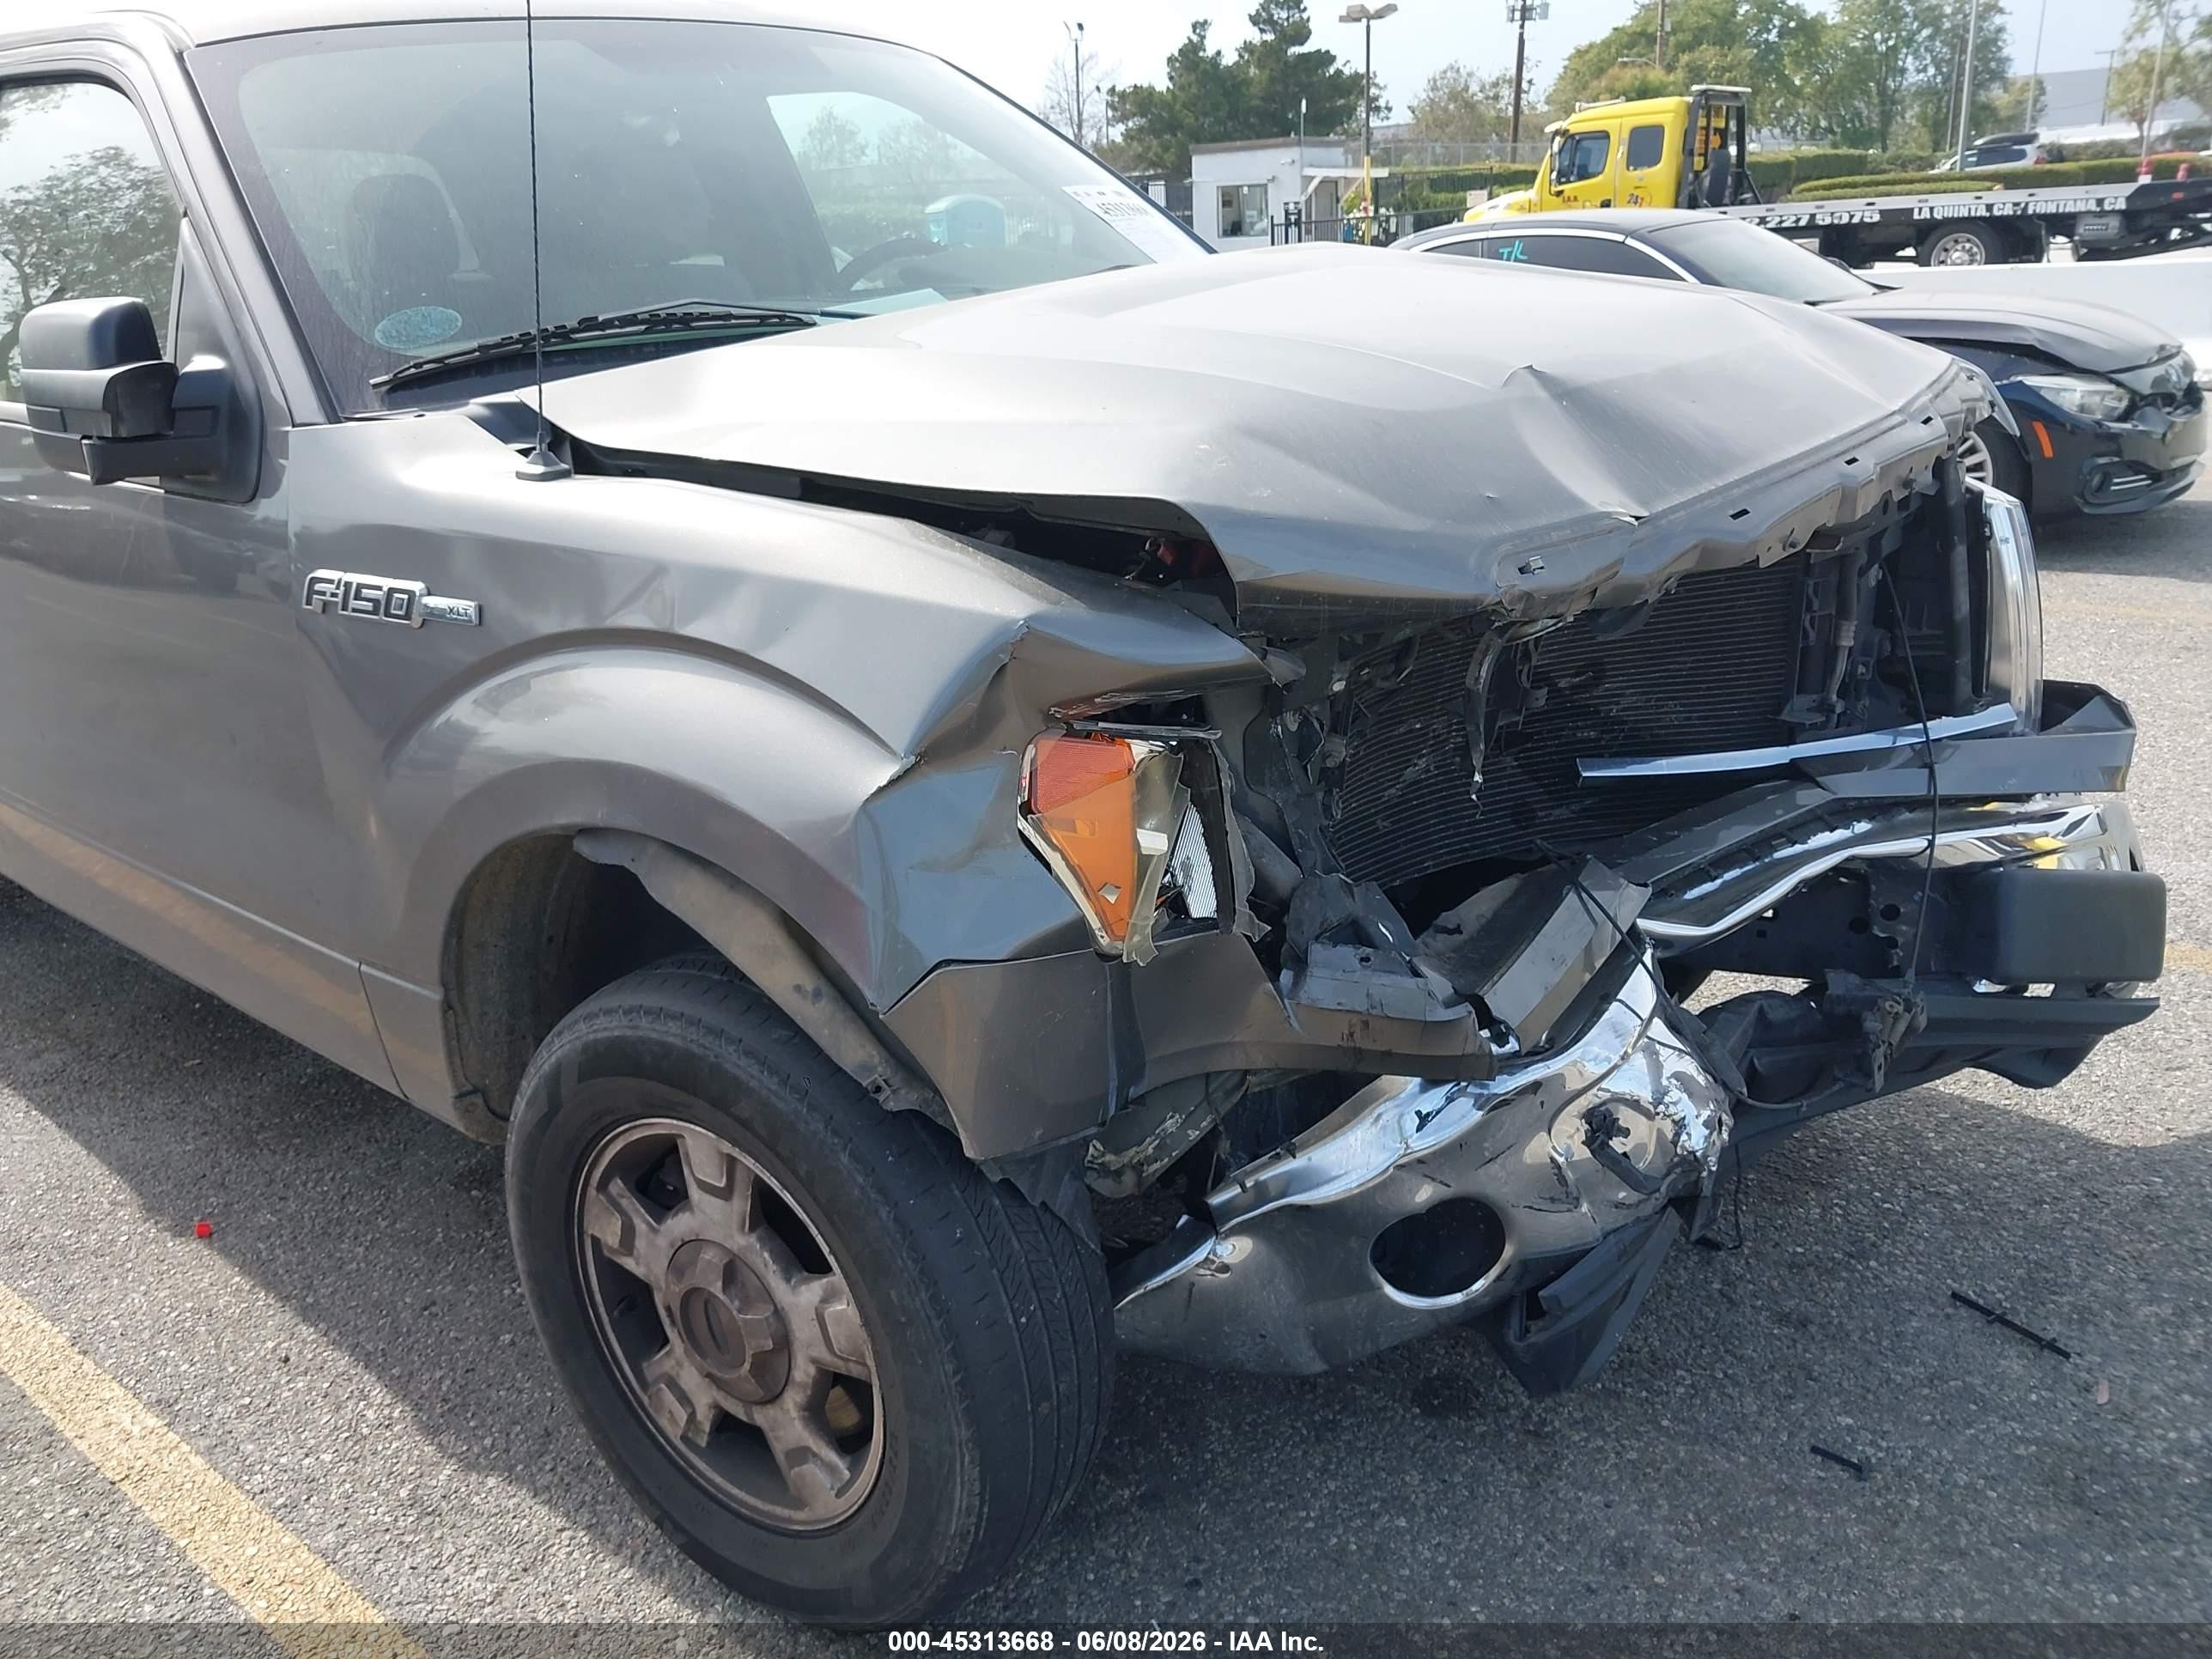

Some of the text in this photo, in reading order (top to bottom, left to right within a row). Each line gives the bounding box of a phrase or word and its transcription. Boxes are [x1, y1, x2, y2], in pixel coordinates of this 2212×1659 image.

[1912, 207, 1930, 220] LA
[1933, 204, 1990, 219] QUINTA,
[1993, 203, 2014, 216] CA
[2027, 198, 2102, 214] FONTANA,
[2103, 196, 2127, 211] CA
[1815, 210, 1881, 226] 5075
[446, 605, 471, 618] XLT
